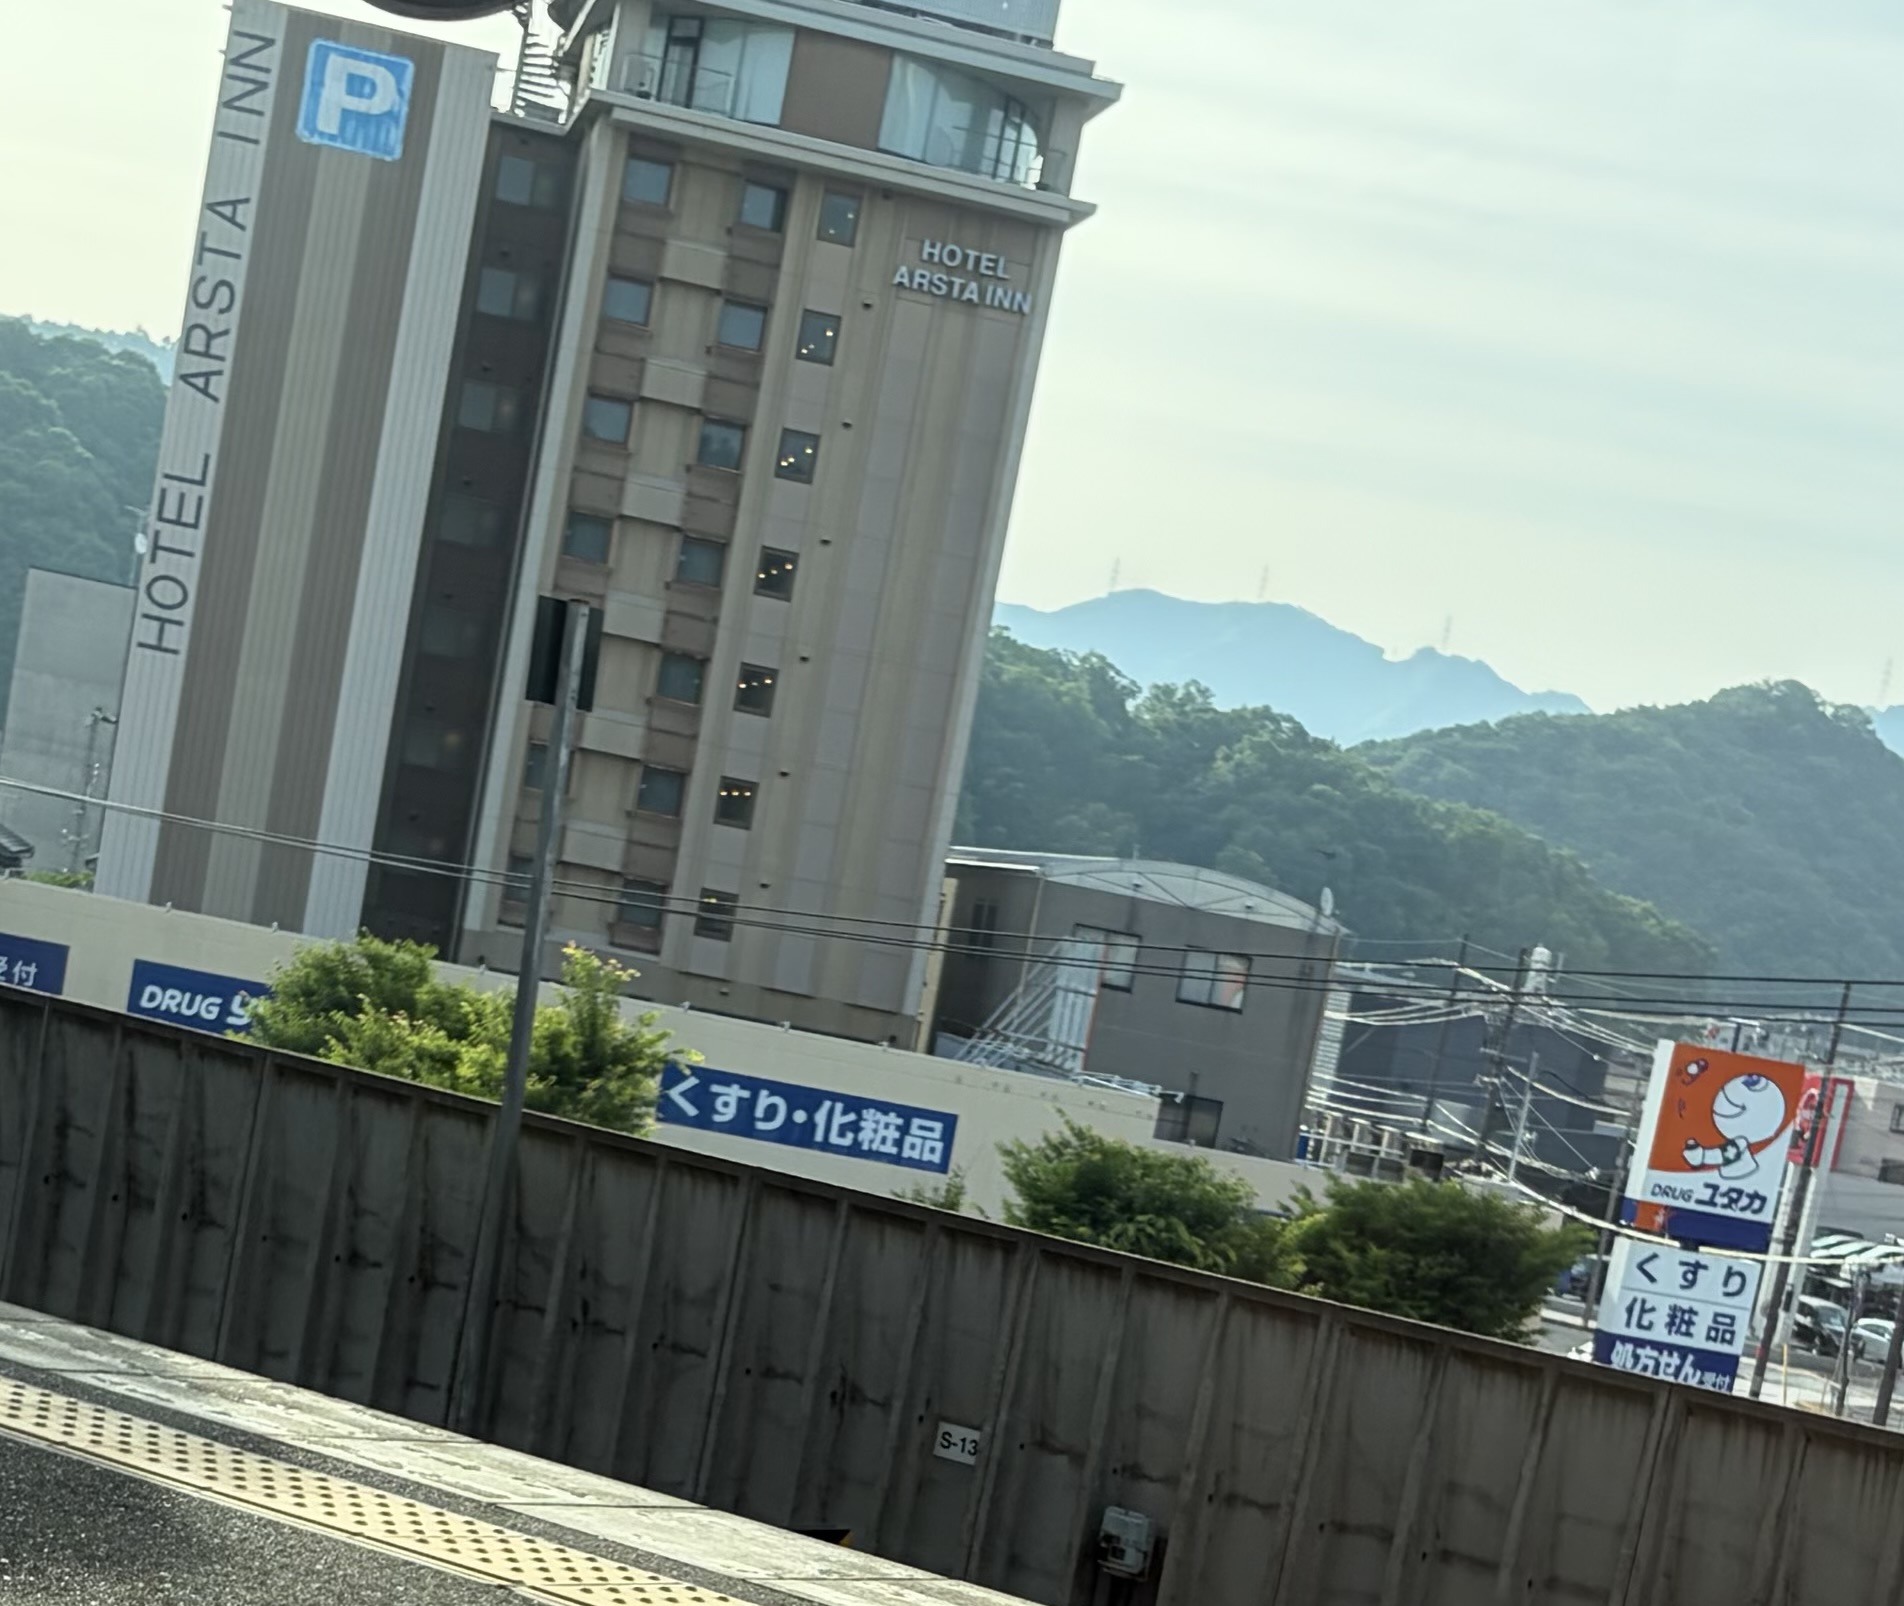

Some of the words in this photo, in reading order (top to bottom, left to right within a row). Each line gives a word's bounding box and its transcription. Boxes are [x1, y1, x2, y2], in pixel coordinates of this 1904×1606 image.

[315, 52, 398, 135] P
[922, 239, 1011, 281] HOTEL
[892, 265, 979, 304] ARSTA
[985, 285, 1033, 316] INN
[136, 453, 210, 656] HOTEL
[178, 197, 251, 403] ARSTA
[217, 30, 276, 146] INN
[139, 984, 223, 1021] DRUG
[666, 1075, 945, 1164] くすり・化粧品
[1651, 1183, 1695, 1203] DRUG
[1694, 1182, 1768, 1215] ユタカ
[1636, 1252, 1747, 1298] くすり
[1625, 1297, 1737, 1347] 化粧品
[939, 1431, 979, 1457] S-13
